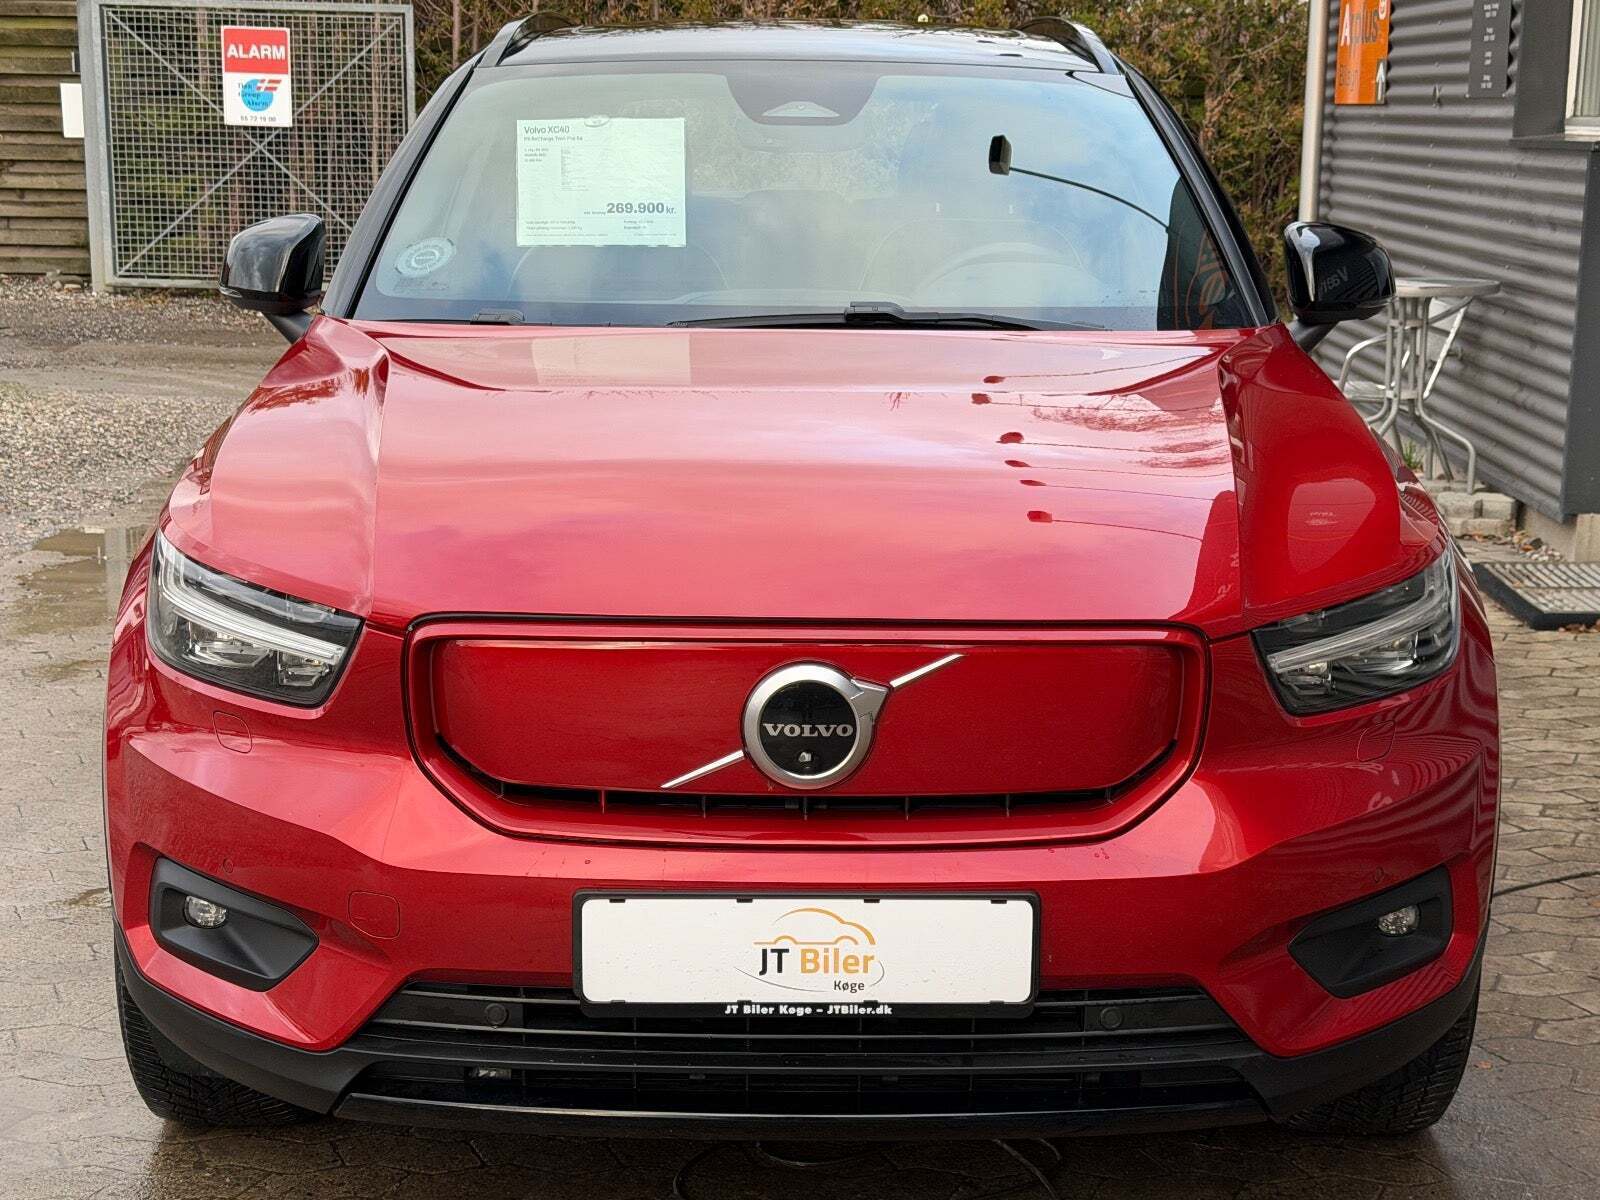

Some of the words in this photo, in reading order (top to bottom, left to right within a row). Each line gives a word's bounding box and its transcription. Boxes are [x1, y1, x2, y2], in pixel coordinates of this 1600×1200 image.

[227, 44, 286, 60] ALARM
[524, 126, 546, 134] Volvo
[547, 125, 570, 134] XC40
[606, 202, 665, 214] 269.900
[666, 205, 677, 214] kr.
[763, 723, 854, 737] VOLVO
[759, 948, 790, 976] JT
[800, 947, 875, 974] Biler
[833, 980, 865, 993] Køge
[725, 1005, 739, 1015] JT
[743, 1005, 775, 1015] Biler
[779, 1005, 813, 1017] Køge
[827, 1005, 893, 1015] JTBiler.dk
